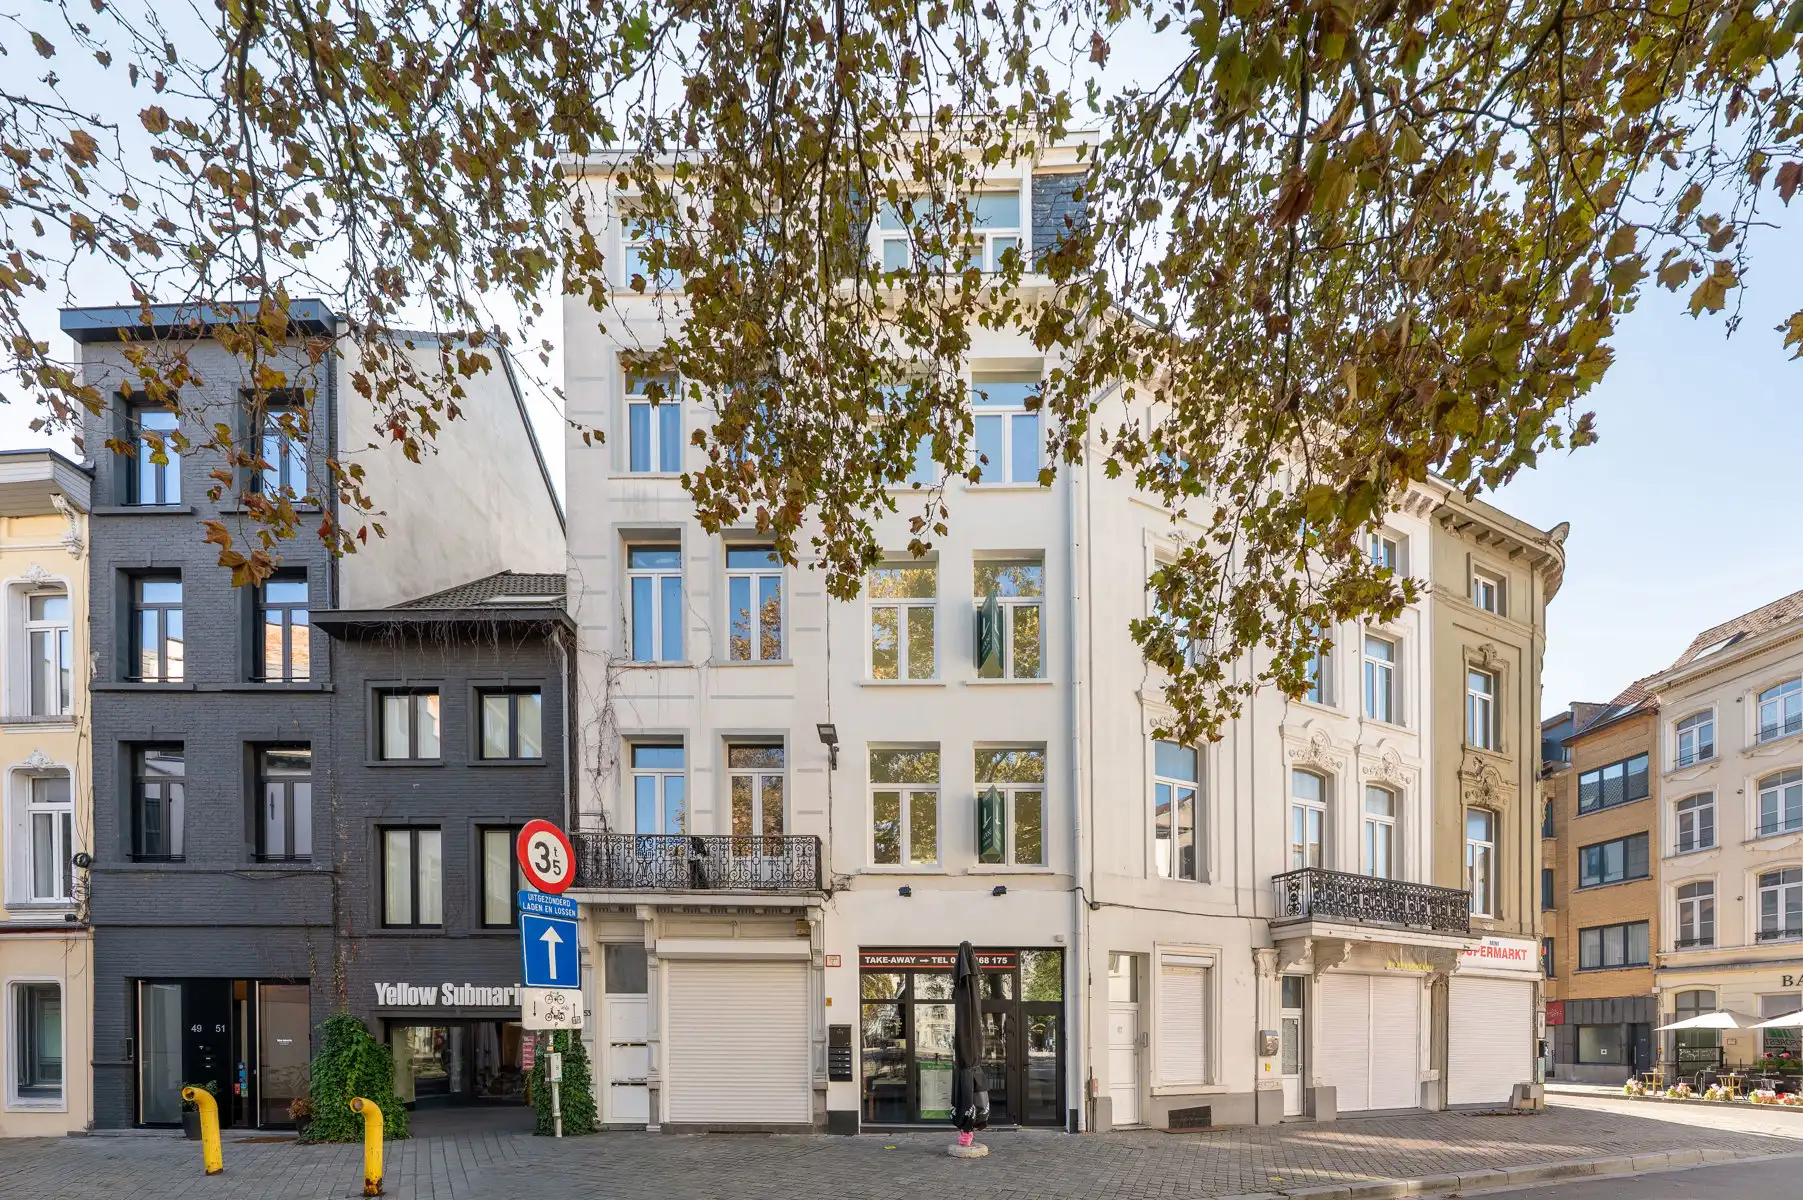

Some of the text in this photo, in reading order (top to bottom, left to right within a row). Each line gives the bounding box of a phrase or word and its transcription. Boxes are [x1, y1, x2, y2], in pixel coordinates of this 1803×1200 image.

[534, 841, 551, 873] 3
[527, 893, 571, 907] UITGEZONDERD
[522, 901, 543, 912] LADEN
[554, 907, 576, 917] LOSSEN
[864, 956, 916, 964] TAKE-AWAY
[374, 982, 438, 1006] Yellow
[583, 1009, 592, 1017] 53
[191, 1024, 202, 1033] 49
[215, 1024, 226, 1033] 51
